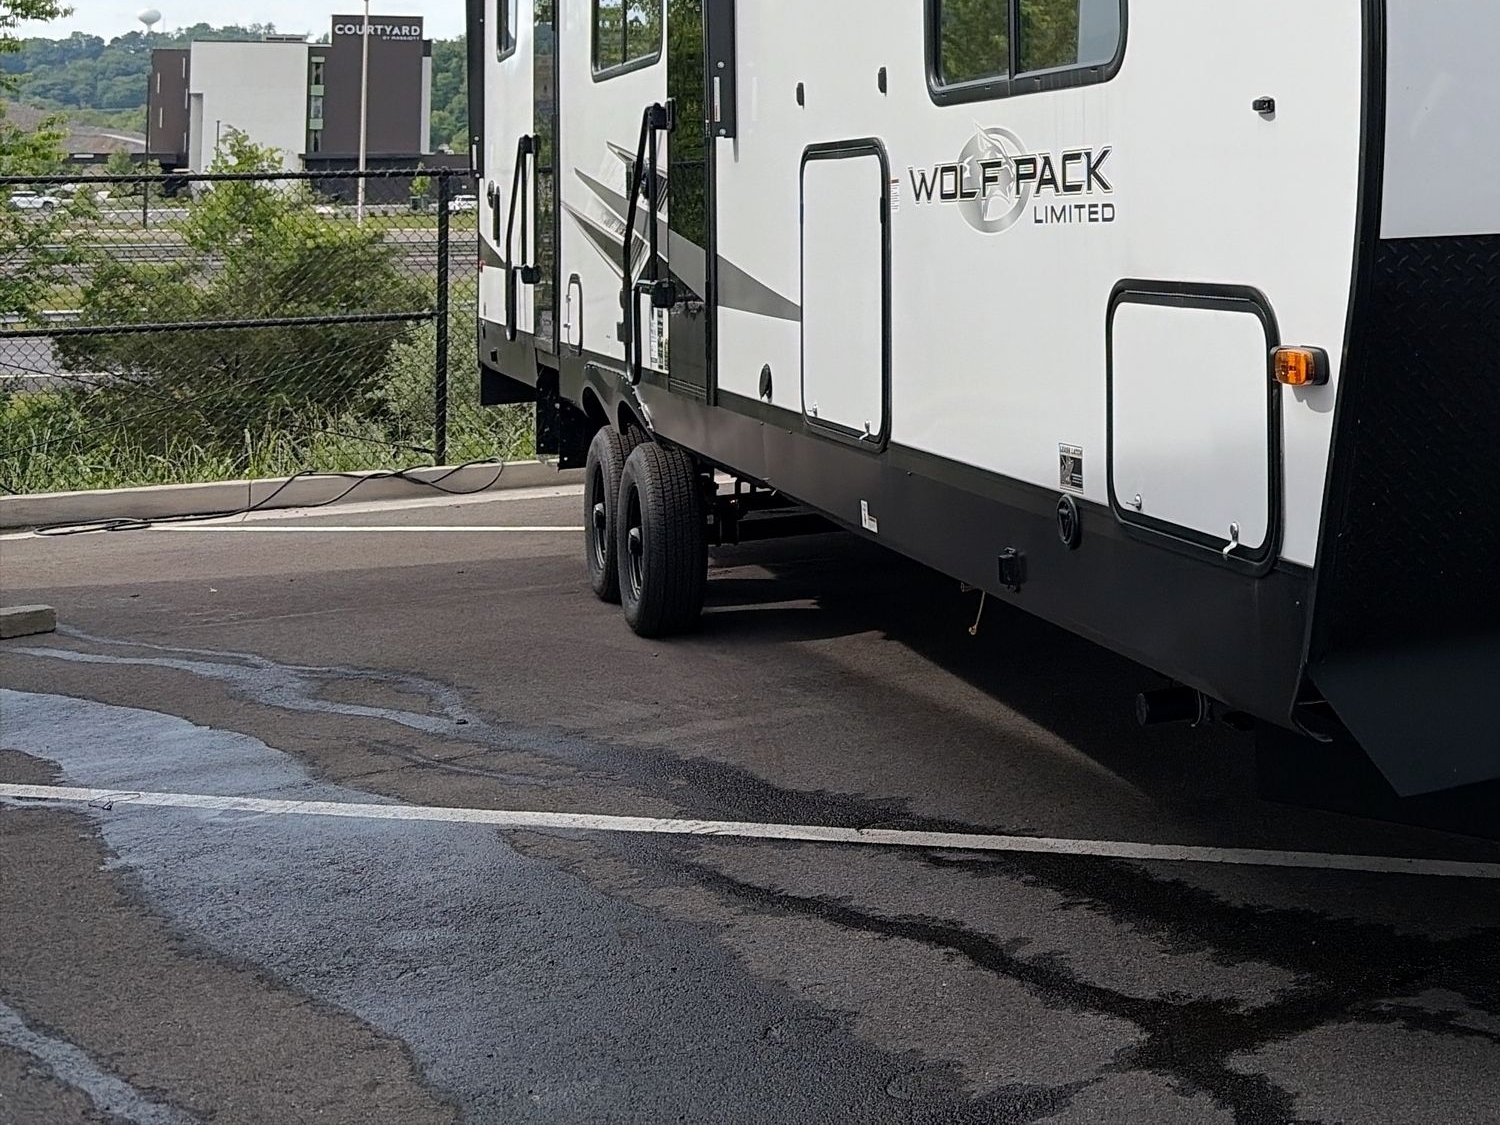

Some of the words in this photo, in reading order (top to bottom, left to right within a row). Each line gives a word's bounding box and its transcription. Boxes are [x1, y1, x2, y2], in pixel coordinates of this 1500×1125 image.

[334, 24, 421, 36] COURTYARD
[907, 158, 1003, 204] WOLF
[1010, 146, 1113, 199] PACK
[1033, 203, 1115, 224] LIMITED
